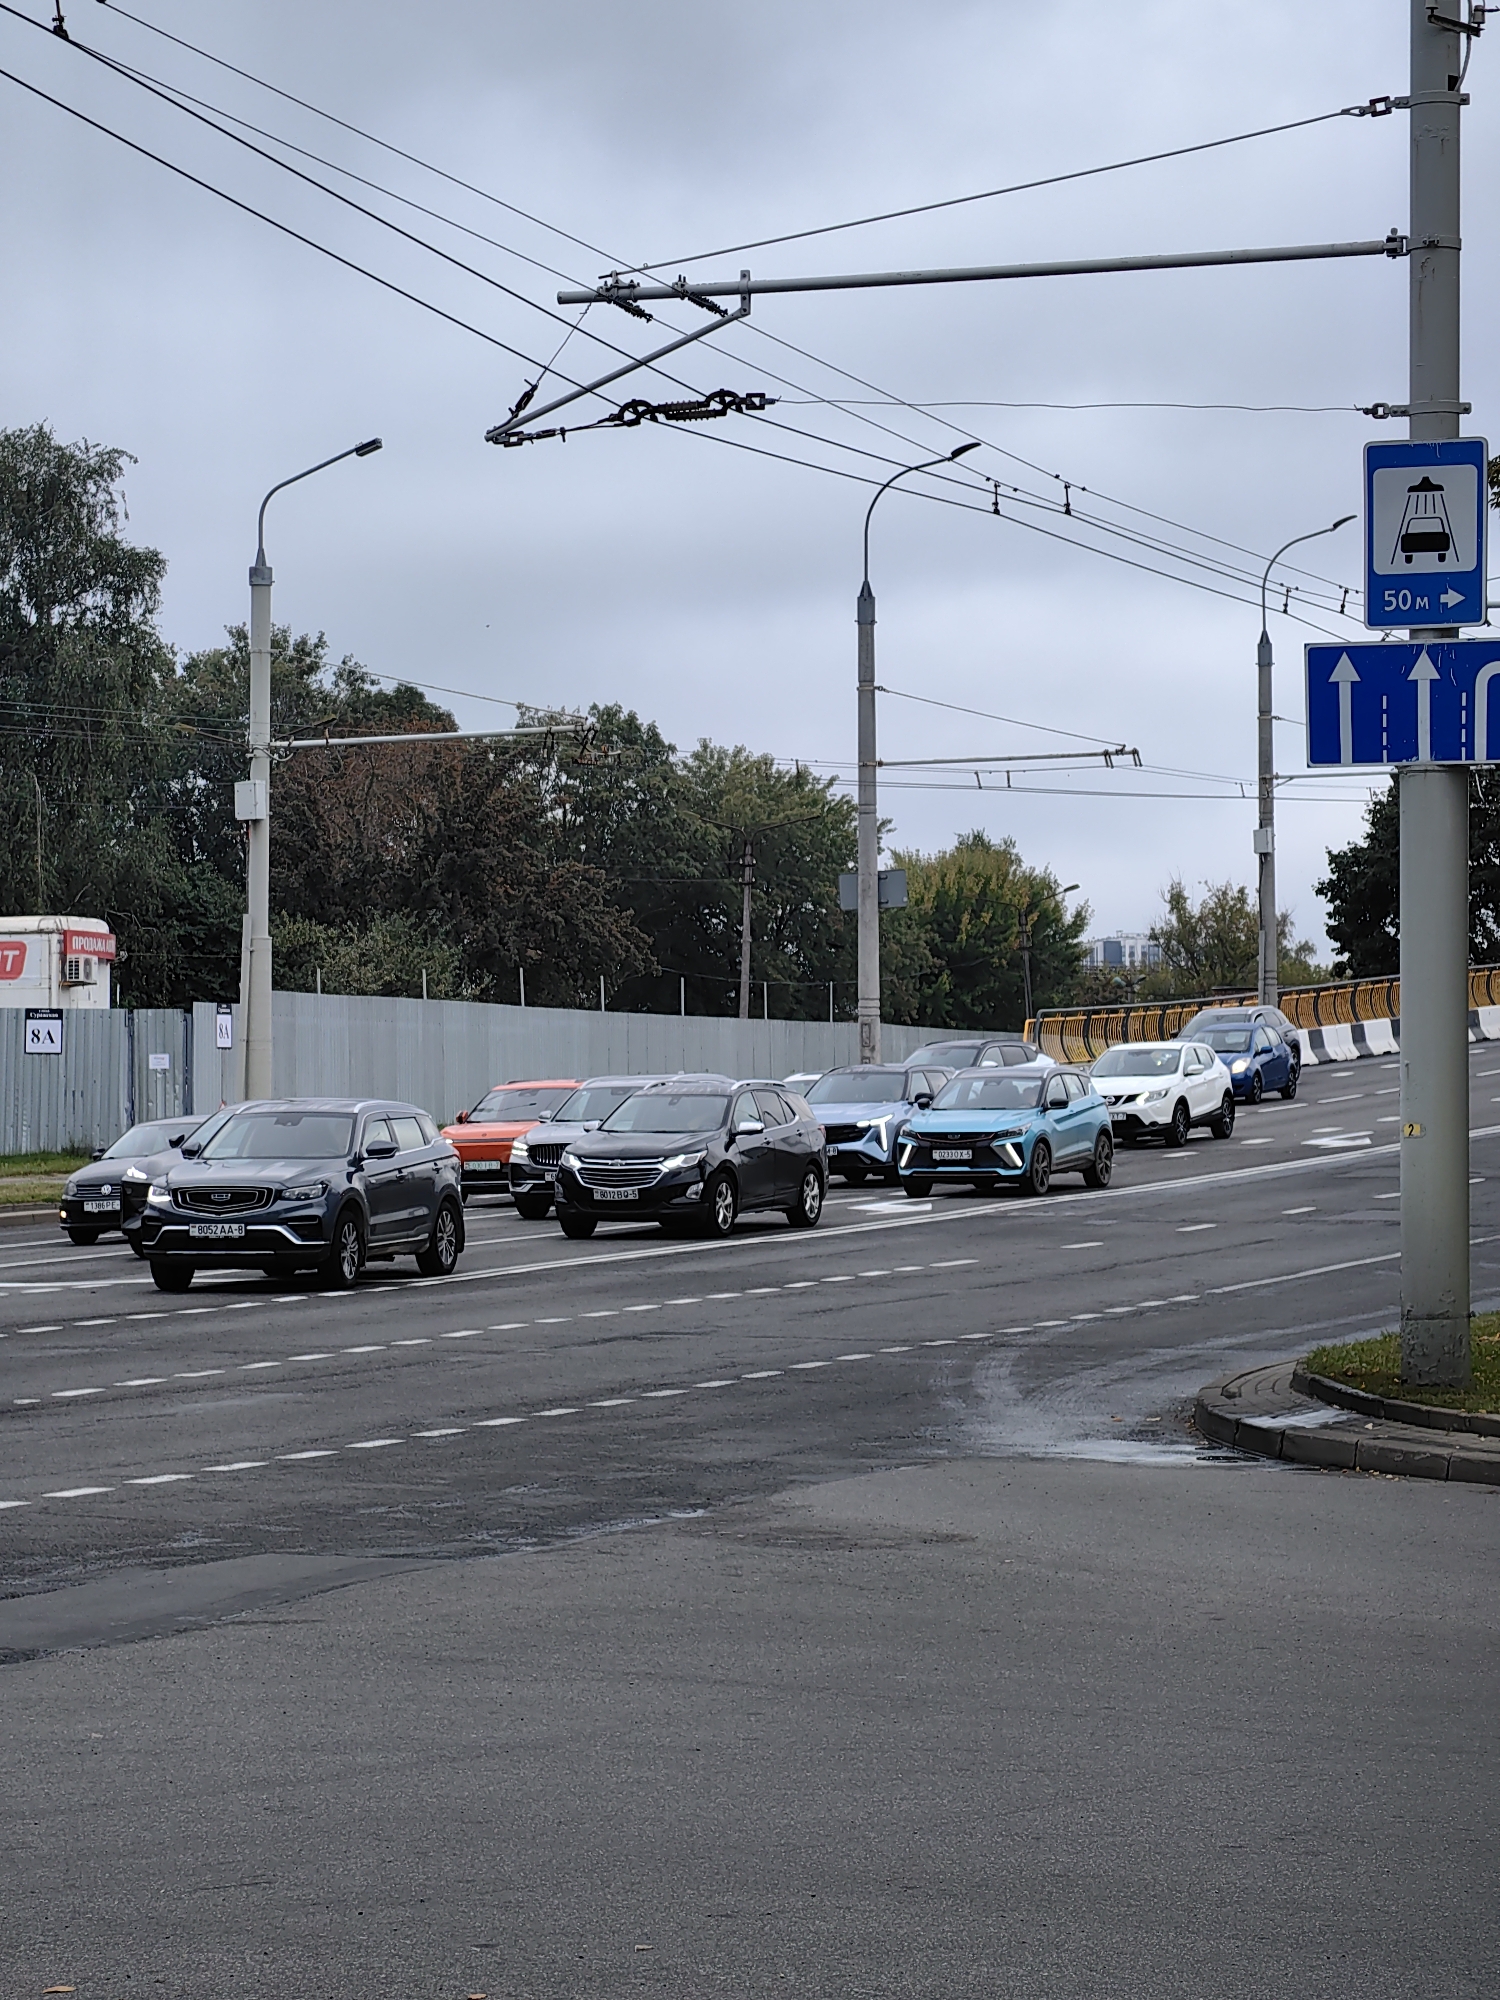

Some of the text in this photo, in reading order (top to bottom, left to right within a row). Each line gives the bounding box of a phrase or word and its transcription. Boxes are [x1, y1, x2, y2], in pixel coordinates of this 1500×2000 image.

[1384, 589, 1411, 611] 50
[72, 935, 106, 953] ПРОДАЖА
[0, 949, 20, 972] Т
[31, 1028, 56, 1045] 8А
[197, 1224, 244, 1236] 8052AA-8
